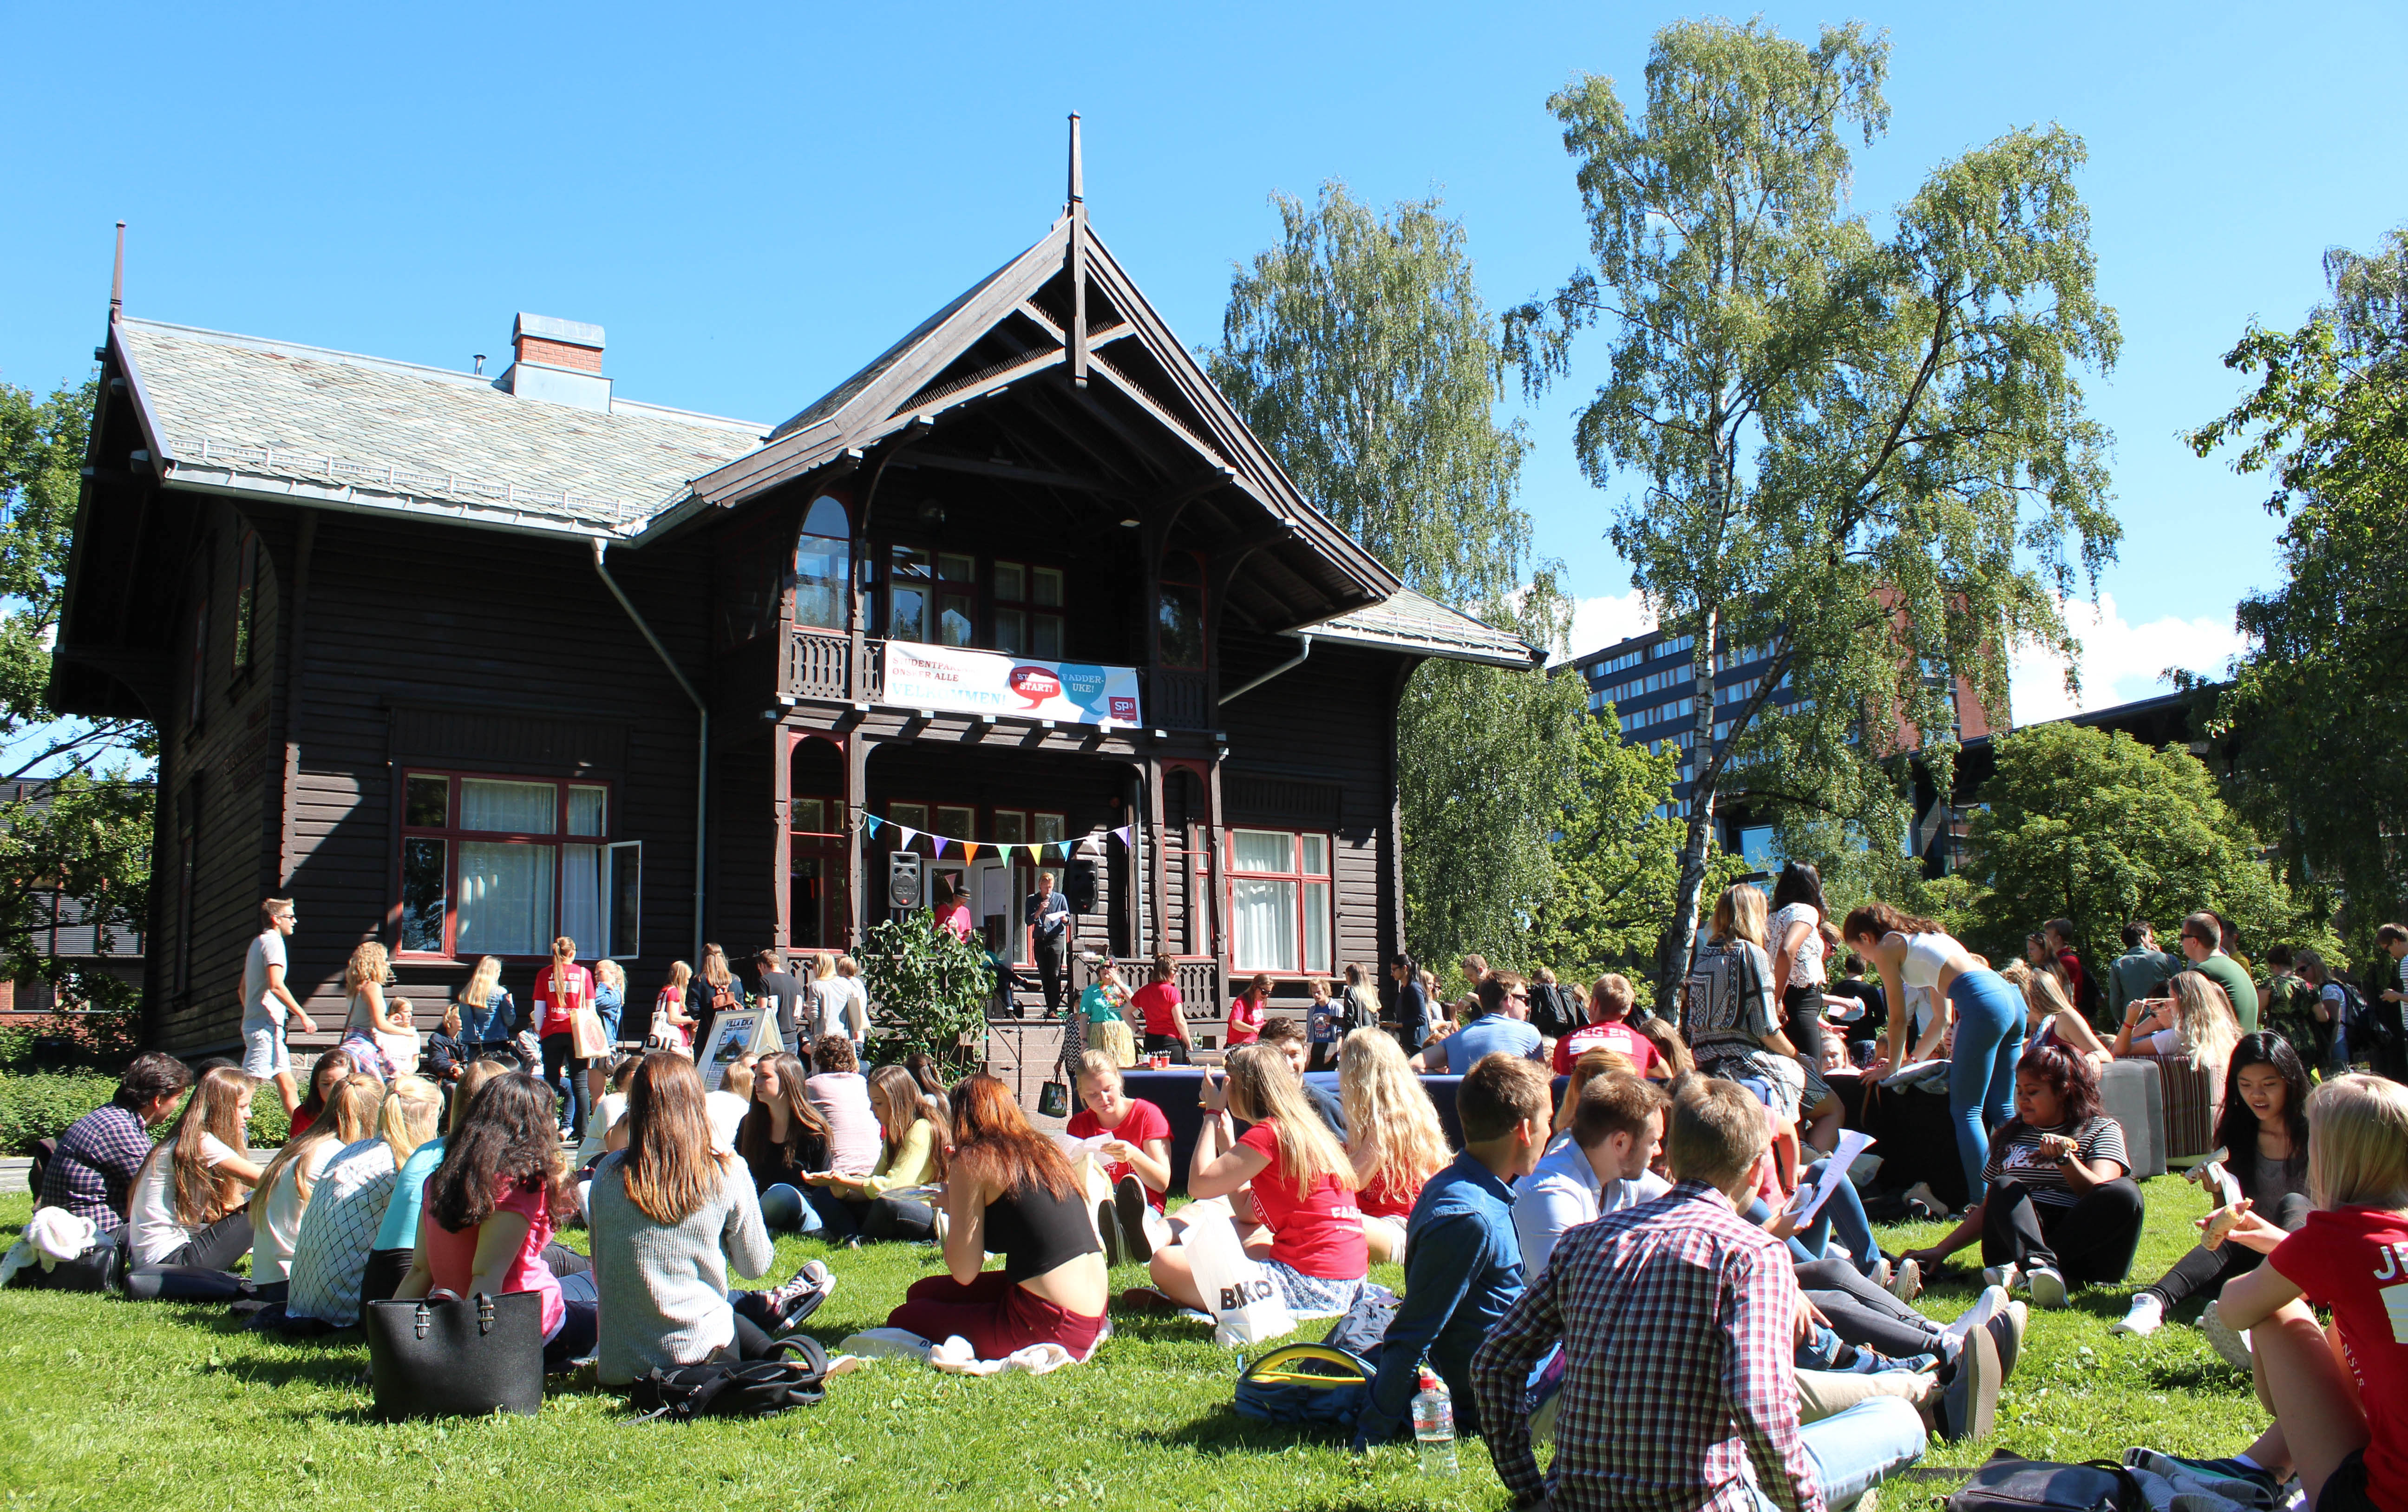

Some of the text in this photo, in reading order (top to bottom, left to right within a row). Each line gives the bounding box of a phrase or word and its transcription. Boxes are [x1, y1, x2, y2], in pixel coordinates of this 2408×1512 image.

[934, 673, 959, 682] ALLE
[1062, 673, 1104, 684] FADDER-
[1019, 681, 1053, 693] START!
[1072, 683, 1094, 693] UKE!
[1115, 701, 1129, 711] SP
[1572, 1026, 1632, 1039] JEG ER
